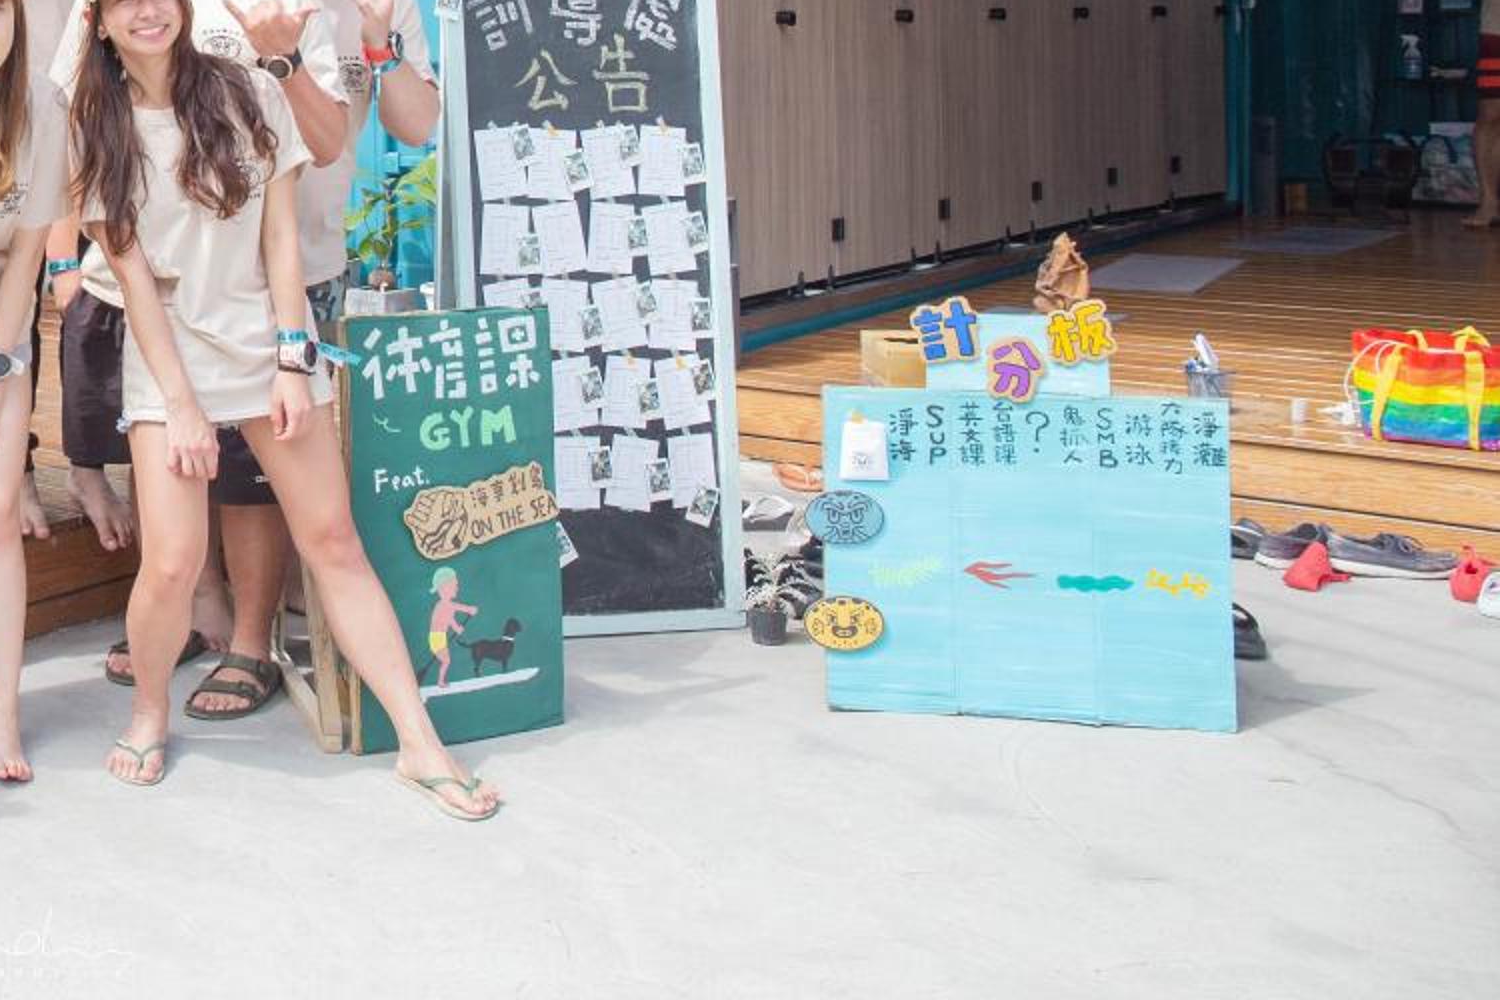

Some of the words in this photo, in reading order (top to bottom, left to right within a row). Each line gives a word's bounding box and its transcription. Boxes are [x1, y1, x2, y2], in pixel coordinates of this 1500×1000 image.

[513, 32, 651, 114] 公告
[912, 298, 1115, 399] 計分板
[419, 405, 517, 451] GYM
[926, 405, 948, 464] SUP
[958, 401, 985, 465] 英文課
[993, 402, 1017, 463] 台語課
[1096, 407, 1118, 468] SMB
[1126, 413, 1153, 466] 游泳
[374, 465, 431, 494] Feat.
[471, 515, 494, 539] ON
[496, 505, 525, 530] THE
[530, 494, 557, 520] SEA
